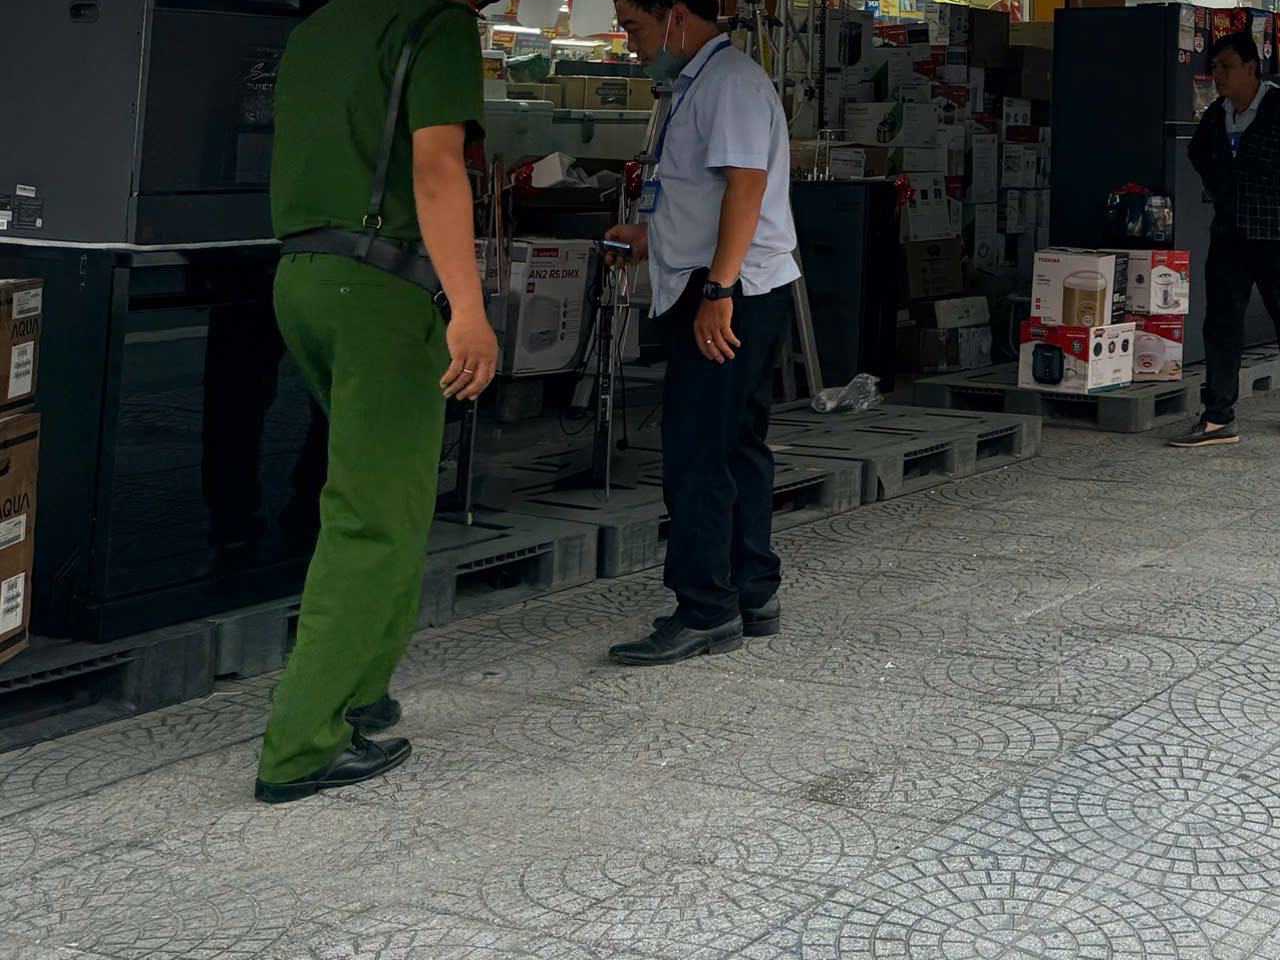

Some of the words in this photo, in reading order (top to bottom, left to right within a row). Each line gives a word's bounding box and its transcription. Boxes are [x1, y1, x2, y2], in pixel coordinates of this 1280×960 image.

[1038, 256, 1061, 264] TOSHIBA
[561, 269, 580, 280] DMX
[11, 317, 40, 339] AQUA
